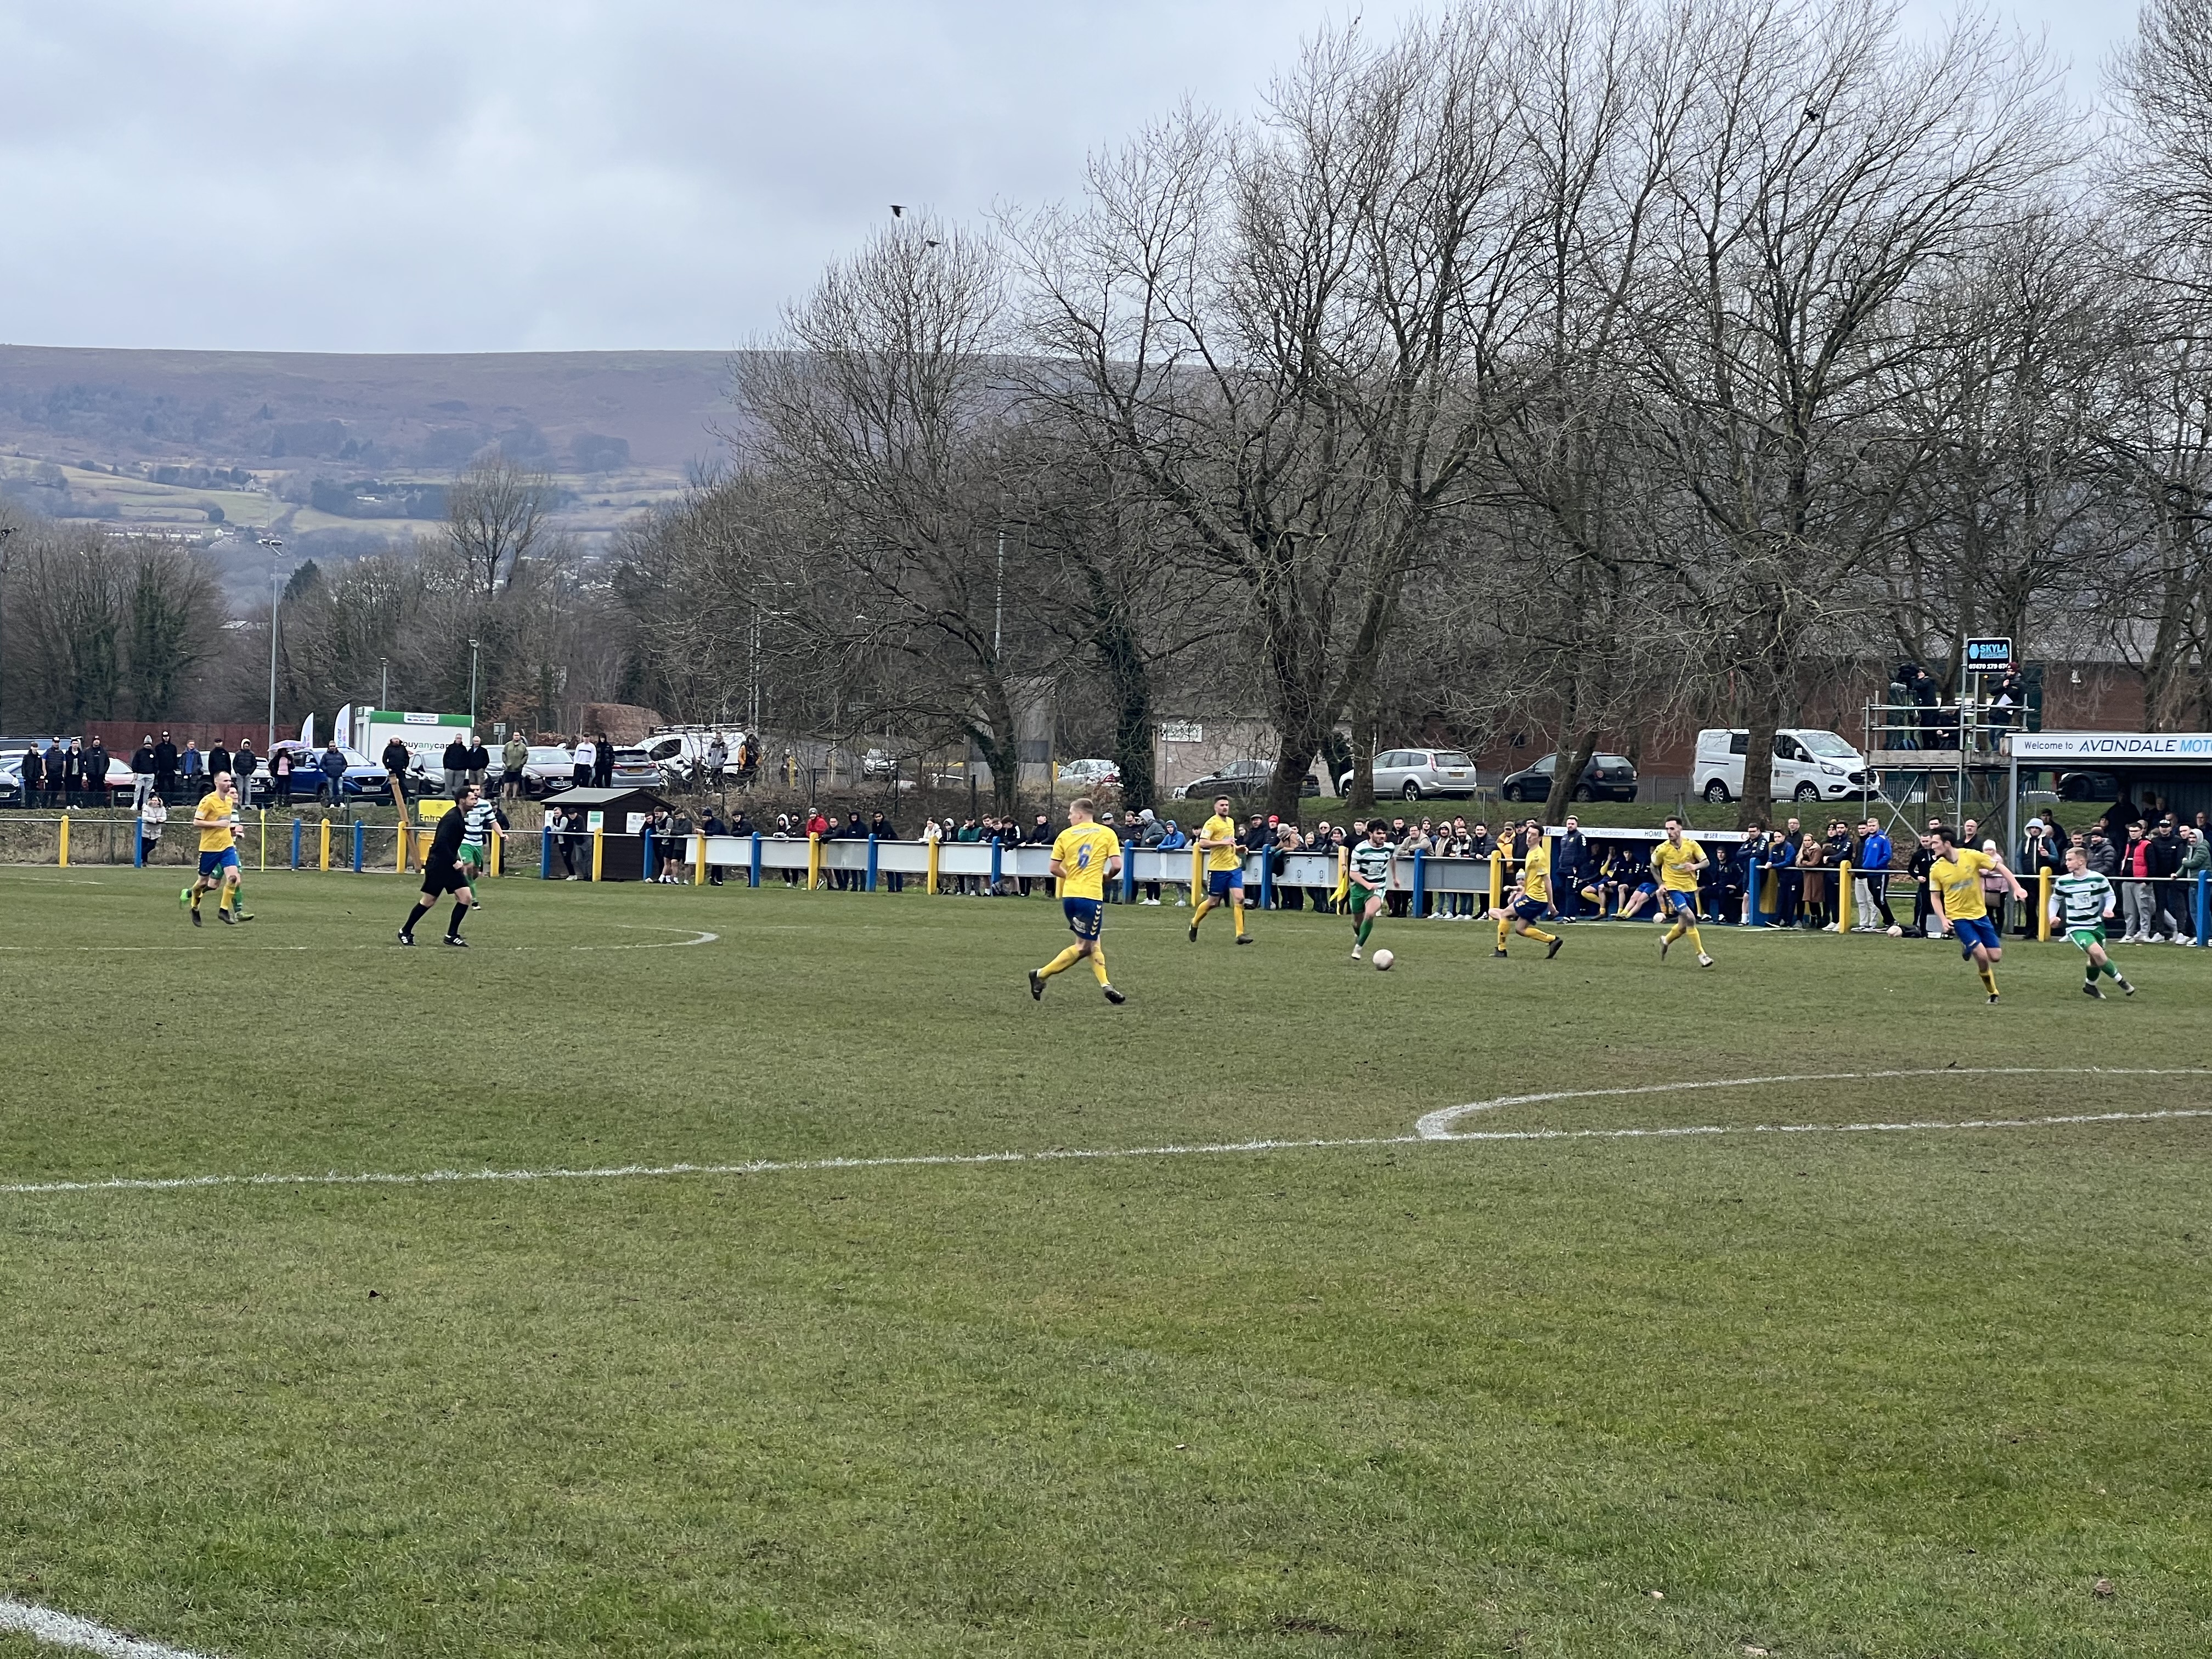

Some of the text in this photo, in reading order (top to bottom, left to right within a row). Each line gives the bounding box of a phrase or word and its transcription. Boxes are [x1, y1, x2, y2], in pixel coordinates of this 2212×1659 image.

[1980, 644, 2007, 653] SKYLA
[2024, 740, 2212, 752] Welcome to AVONDALE MOT
[1077, 843, 1092, 870] 6
